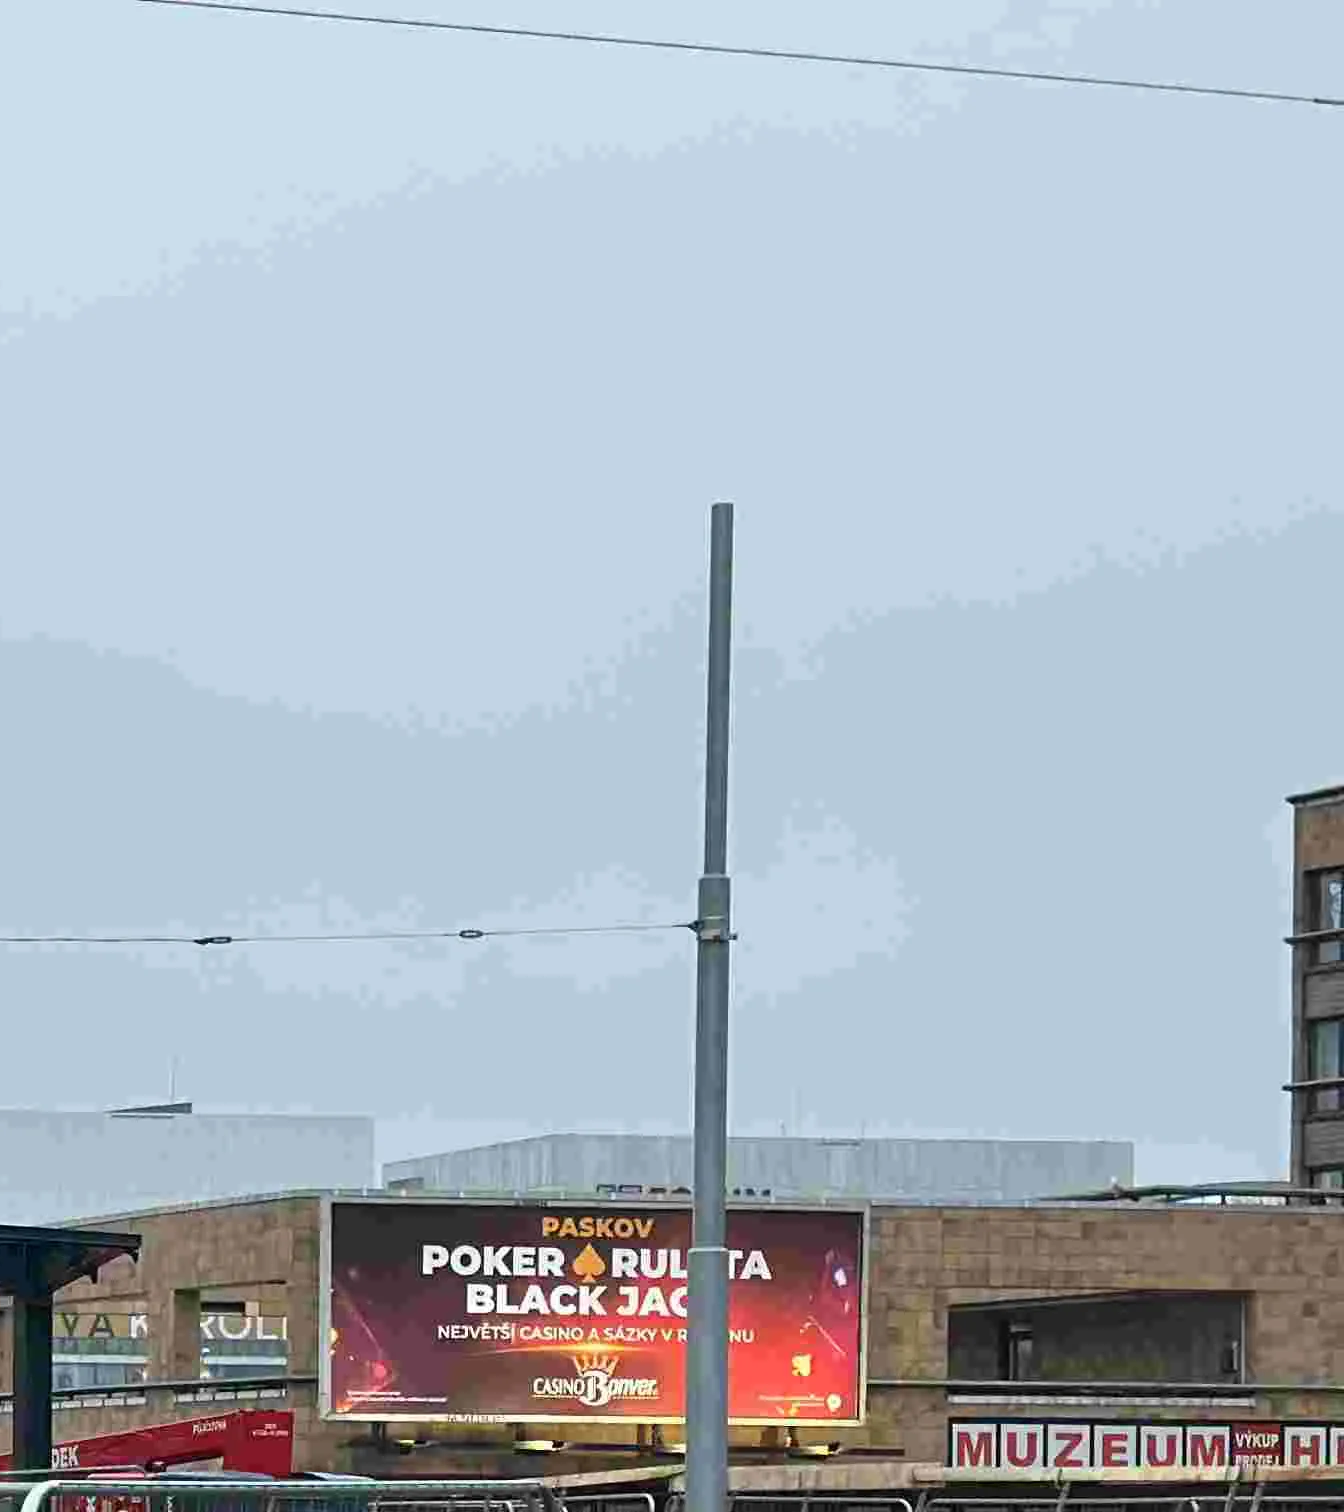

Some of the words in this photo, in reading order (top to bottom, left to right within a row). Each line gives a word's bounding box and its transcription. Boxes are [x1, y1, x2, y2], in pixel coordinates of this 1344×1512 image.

[542, 1216, 654, 1238] PASKOV
[422, 1244, 565, 1277] POKER
[612, 1247, 772, 1280] RULTA
[466, 1283, 607, 1316] BLACK
[616, 1285, 688, 1317] JA
[519, 1325, 583, 1342] CASINO
[588, 1328, 600, 1342] A
[604, 1325, 657, 1342] SÁZKY
[533, 1377, 585, 1395] CASINO
[957, 1431, 1226, 1468] MUZEUM
